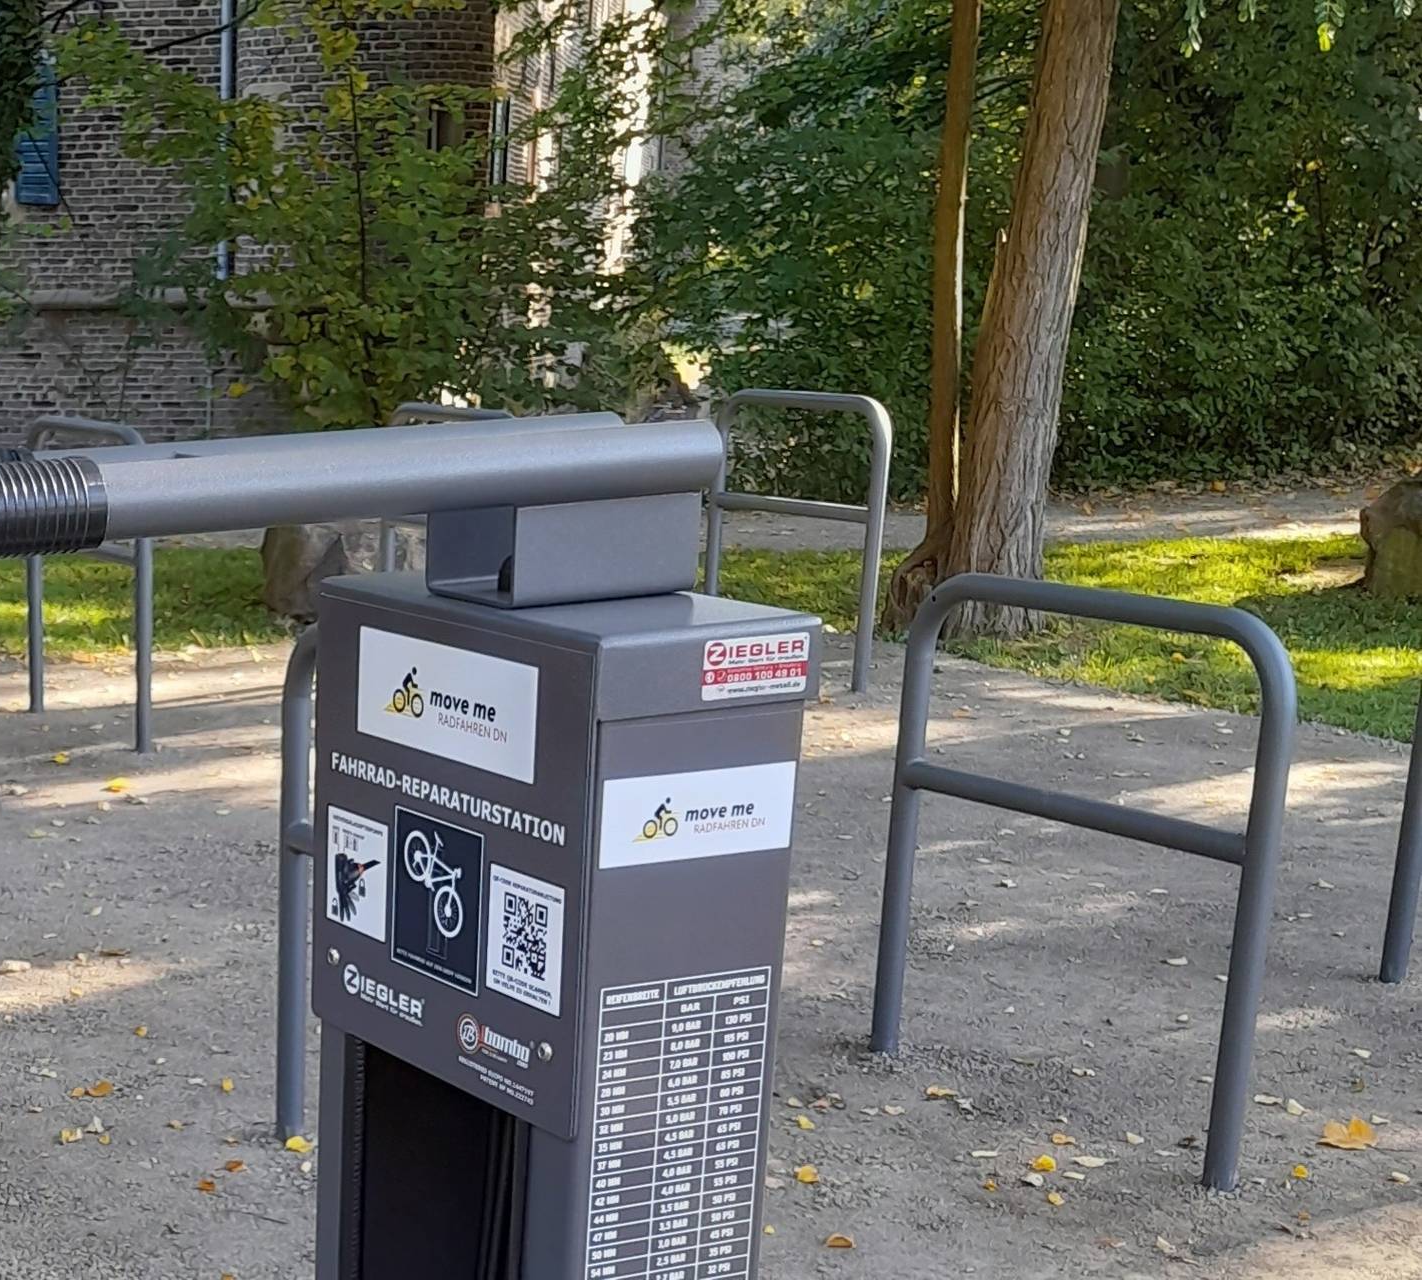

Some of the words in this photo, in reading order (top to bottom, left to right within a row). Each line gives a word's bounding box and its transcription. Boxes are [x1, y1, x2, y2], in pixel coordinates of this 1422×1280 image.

[707, 640, 804, 665] ZIEGLER
[727, 672, 752, 683] 0800
[755, 670, 773, 680] 100
[775, 669, 788, 678] 49
[790, 668, 802, 677] 01
[430, 690, 469, 715] move
[473, 702, 496, 723] me
[438, 712, 491, 739] RADFAHREN
[493, 728, 508, 743] DN
[331, 751, 566, 847] FAHRRAD-REPARATURSTATION
[685, 806, 727, 822] move
[731, 803, 755, 817] me
[693, 819, 748, 834] RADFAHREN
[751, 817, 766, 828] DN
[344, 963, 422, 1018] ZIEGLER
[680, 1002, 700, 1013] BAR
[733, 995, 750, 1005] PSI
[739, 1012, 752, 1023] PSI
[736, 1031, 749, 1042] PSI
[737, 1049, 750, 1060] PSI
[732, 1067, 745, 1078] PSI
[731, 1085, 744, 1096] PSI
[730, 1104, 742, 1114] PSI
[728, 1121, 741, 1132] PSI
[727, 1139, 740, 1150] PSI
[726, 1157, 739, 1168] PSI
[724, 1175, 738, 1185] PSI
[723, 1192, 736, 1203] PSI
[722, 1210, 735, 1220] PSI
[721, 1227, 734, 1238] PSI
[720, 1245, 732, 1255] PSI
[718, 1262, 731, 1273] PSI
